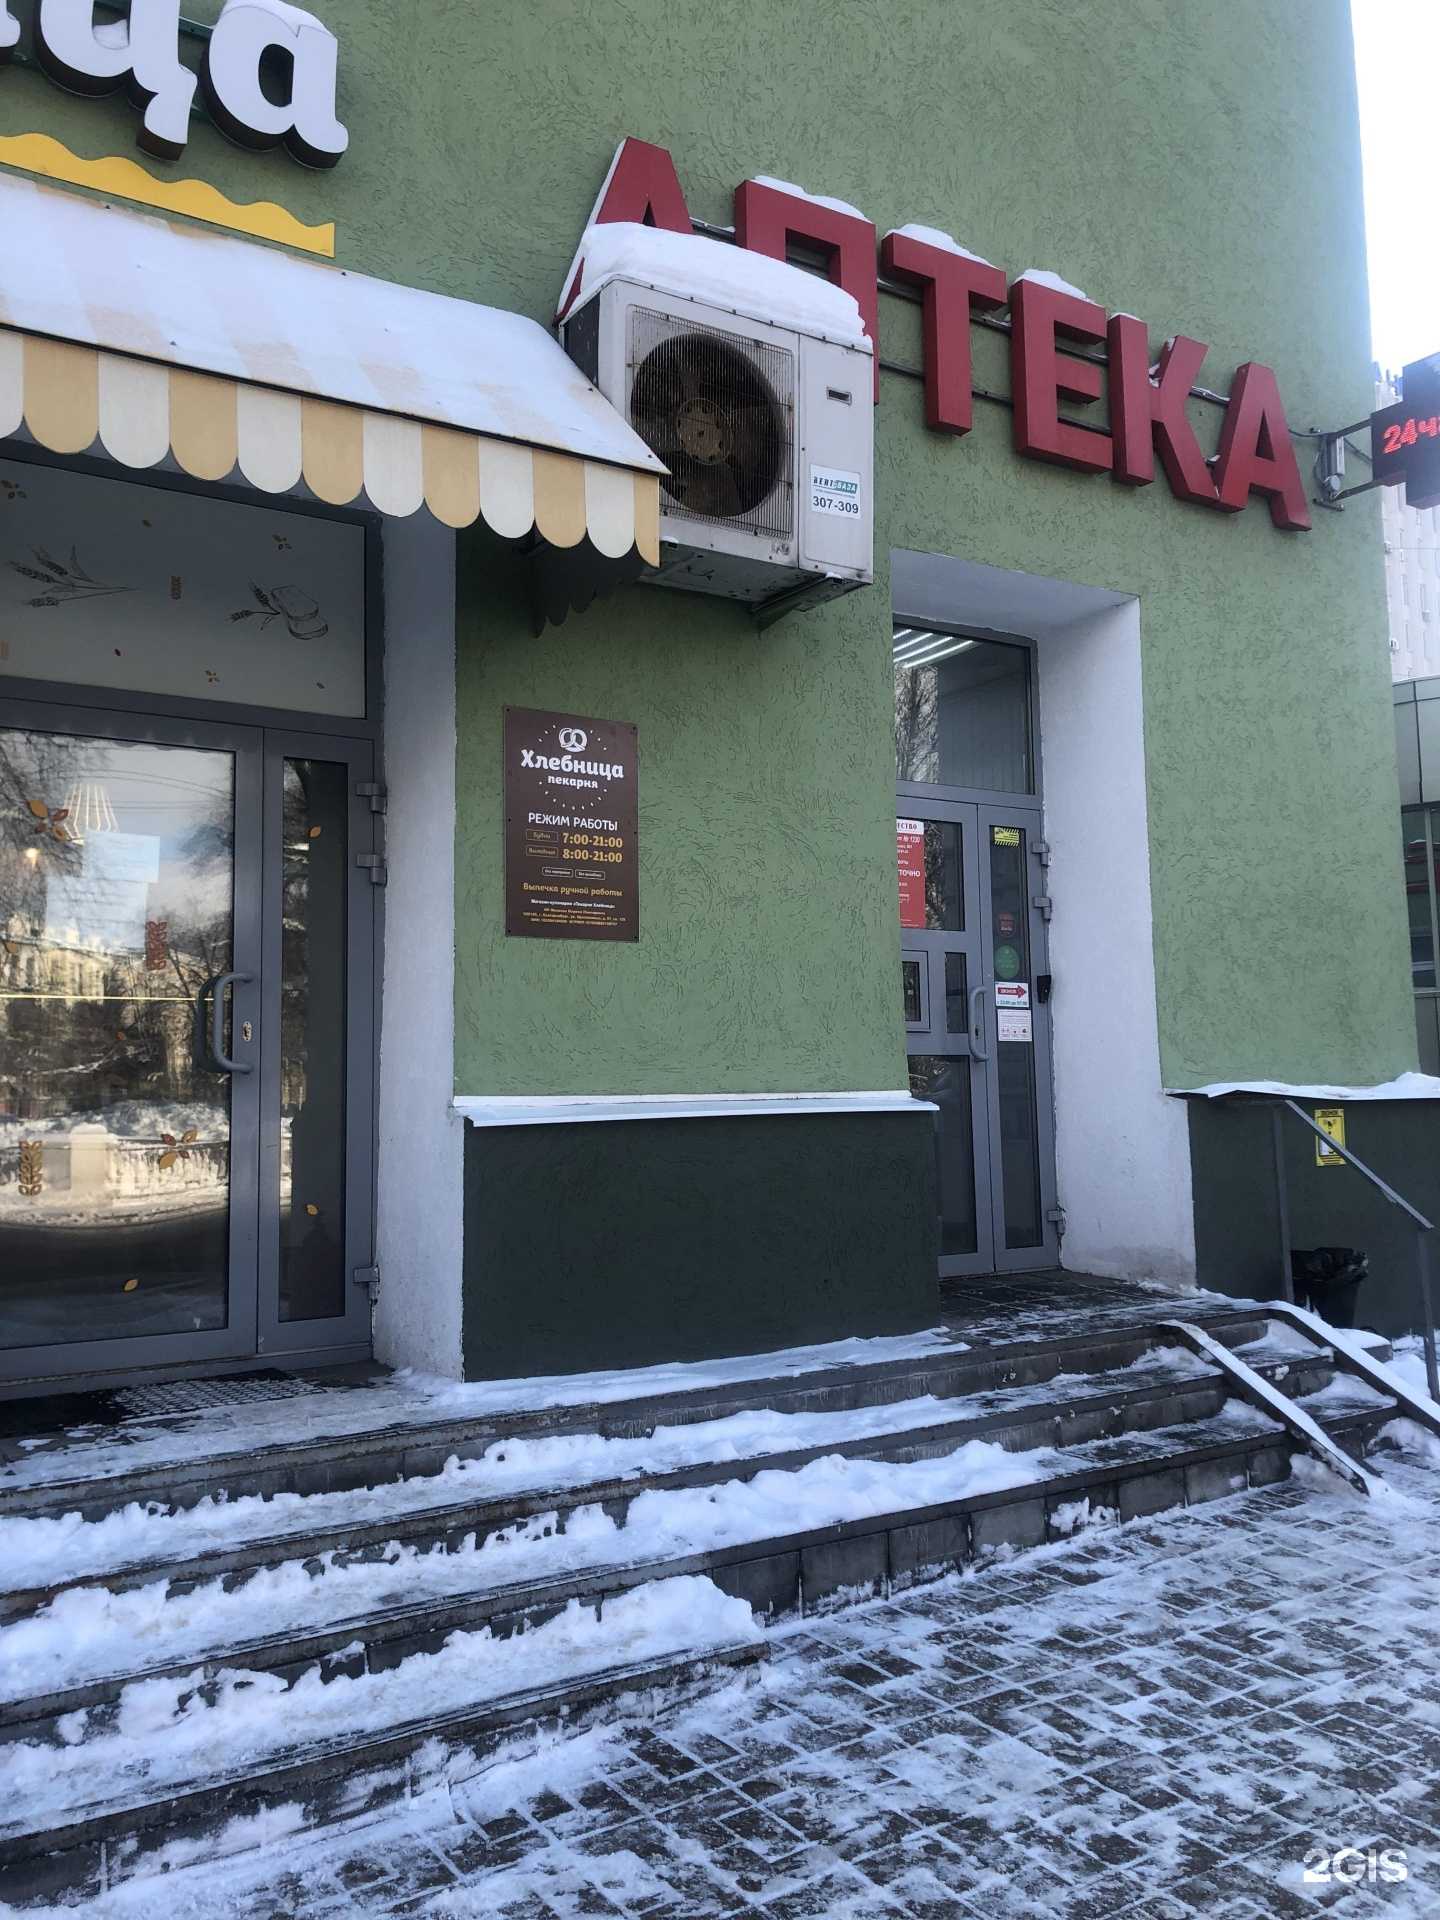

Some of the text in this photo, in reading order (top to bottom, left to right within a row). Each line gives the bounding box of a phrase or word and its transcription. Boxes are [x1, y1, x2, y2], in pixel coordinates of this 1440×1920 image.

[0, 0, 349, 166] ца
[813, 495, 859, 514] 307-309
[521, 749, 624, 780] Хлебница
[547, 775, 598, 789] пекарня
[528, 812, 618, 831] РЕЖИМ РАБОТЫ
[562, 832, 623, 848] 7:00-21:00
[562, 848, 623, 863] 8:00-21:00
[523, 882, 623, 897] Выпечка ручной работы
